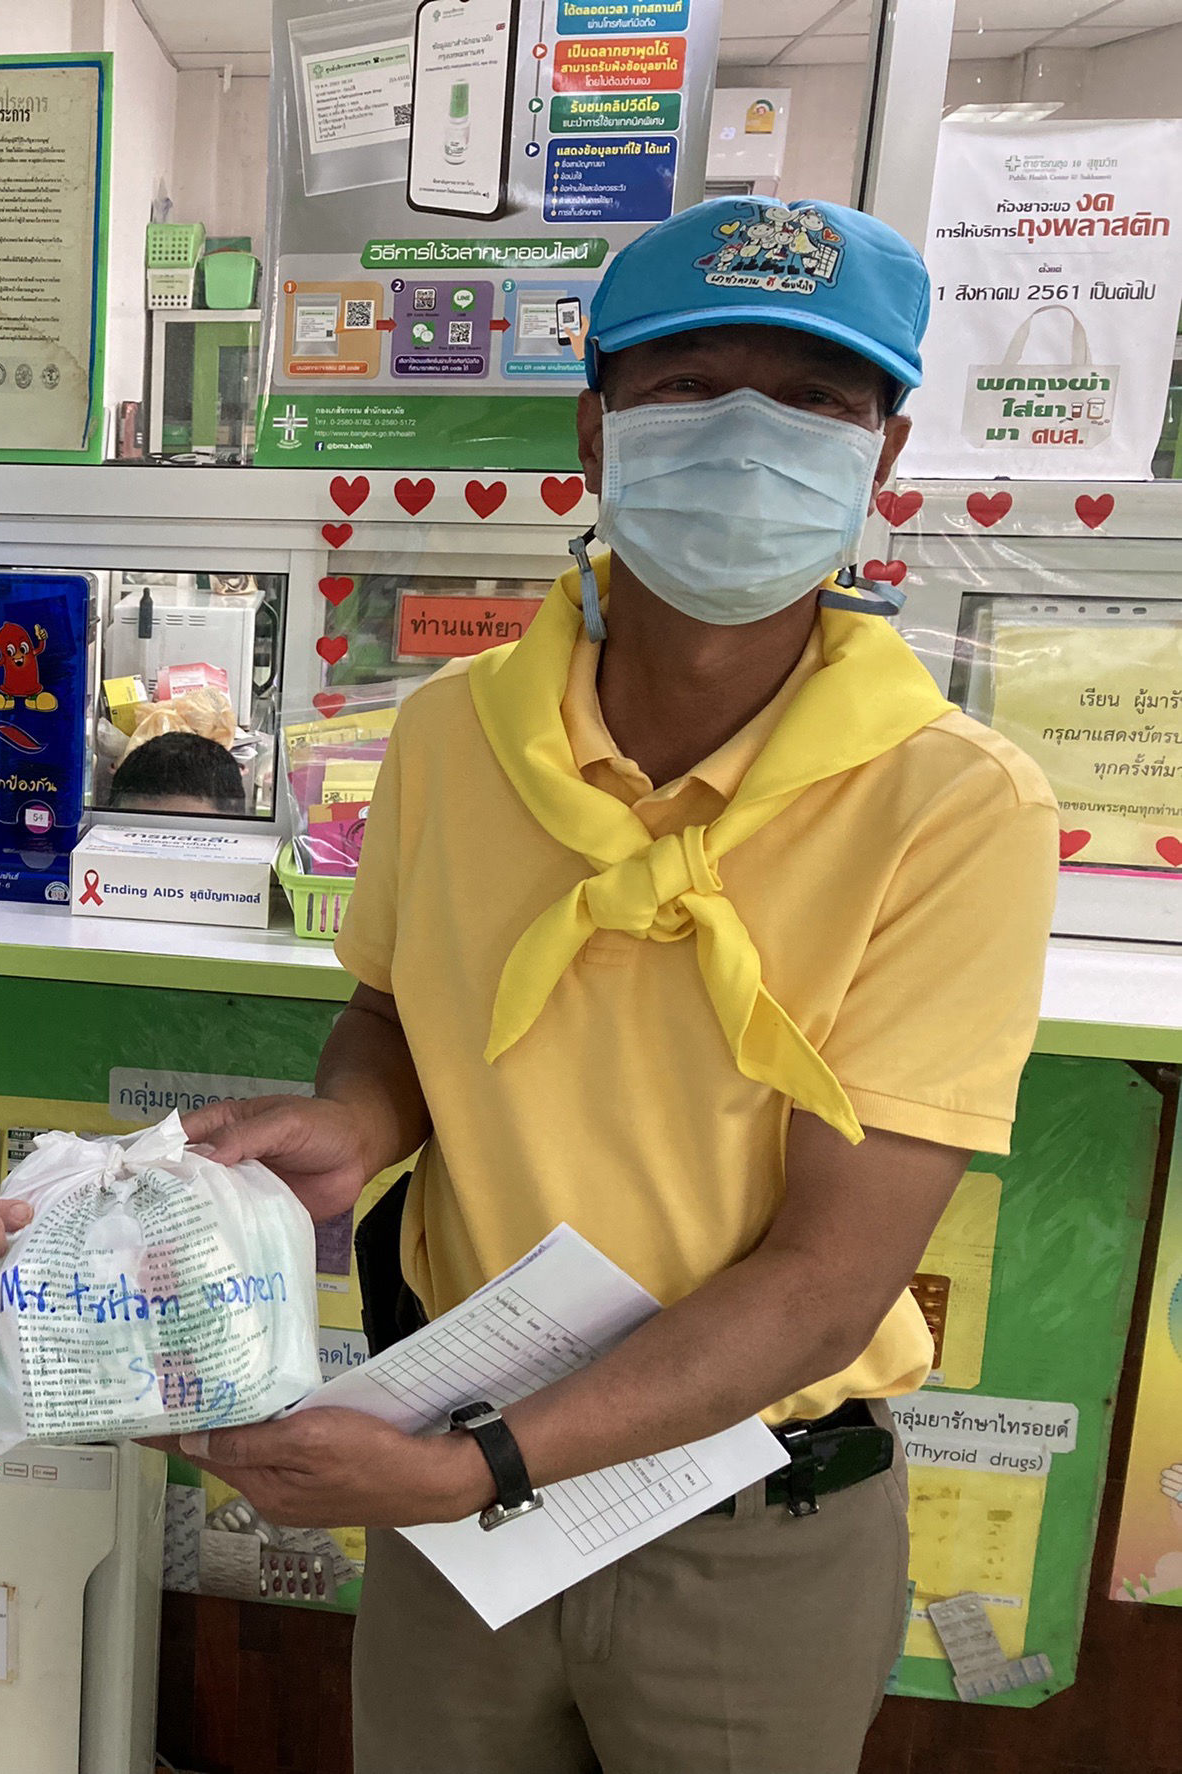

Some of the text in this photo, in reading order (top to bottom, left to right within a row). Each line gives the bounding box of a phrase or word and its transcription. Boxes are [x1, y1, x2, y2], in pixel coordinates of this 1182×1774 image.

[563, 3, 628, 16] ได้ตลอดเวลา
[567, 40, 669, 59] เป็นฉลากยาพูดได้
[645, 142, 671, 155] ได้แก่
[996, 193, 1115, 213] ห้องยาจะขอ งด
[936, 212, 1170, 244] การให้บริการ ถุงพลาสติก
[370, 241, 588, 261] วิธีการใช้ฉลากยาออนไลน์
[394, 282, 402, 291] 2
[504, 281, 512, 291] 3
[937, 280, 1156, 300] 1 สิงหาคม 2561 เป็นต้นไป
[977, 372, 1110, 397] พกถุงผ้า
[1002, 398, 1066, 417] ใส่ยา
[986, 428, 1019, 440] มา
[1080, 687, 1182, 714] เรียน ผู้มารั
[103, 883, 260, 904] Ending AIDS ยุติปัญหาเอดส์
[905, 1442, 1044, 1472] (Thyroid drugs)
